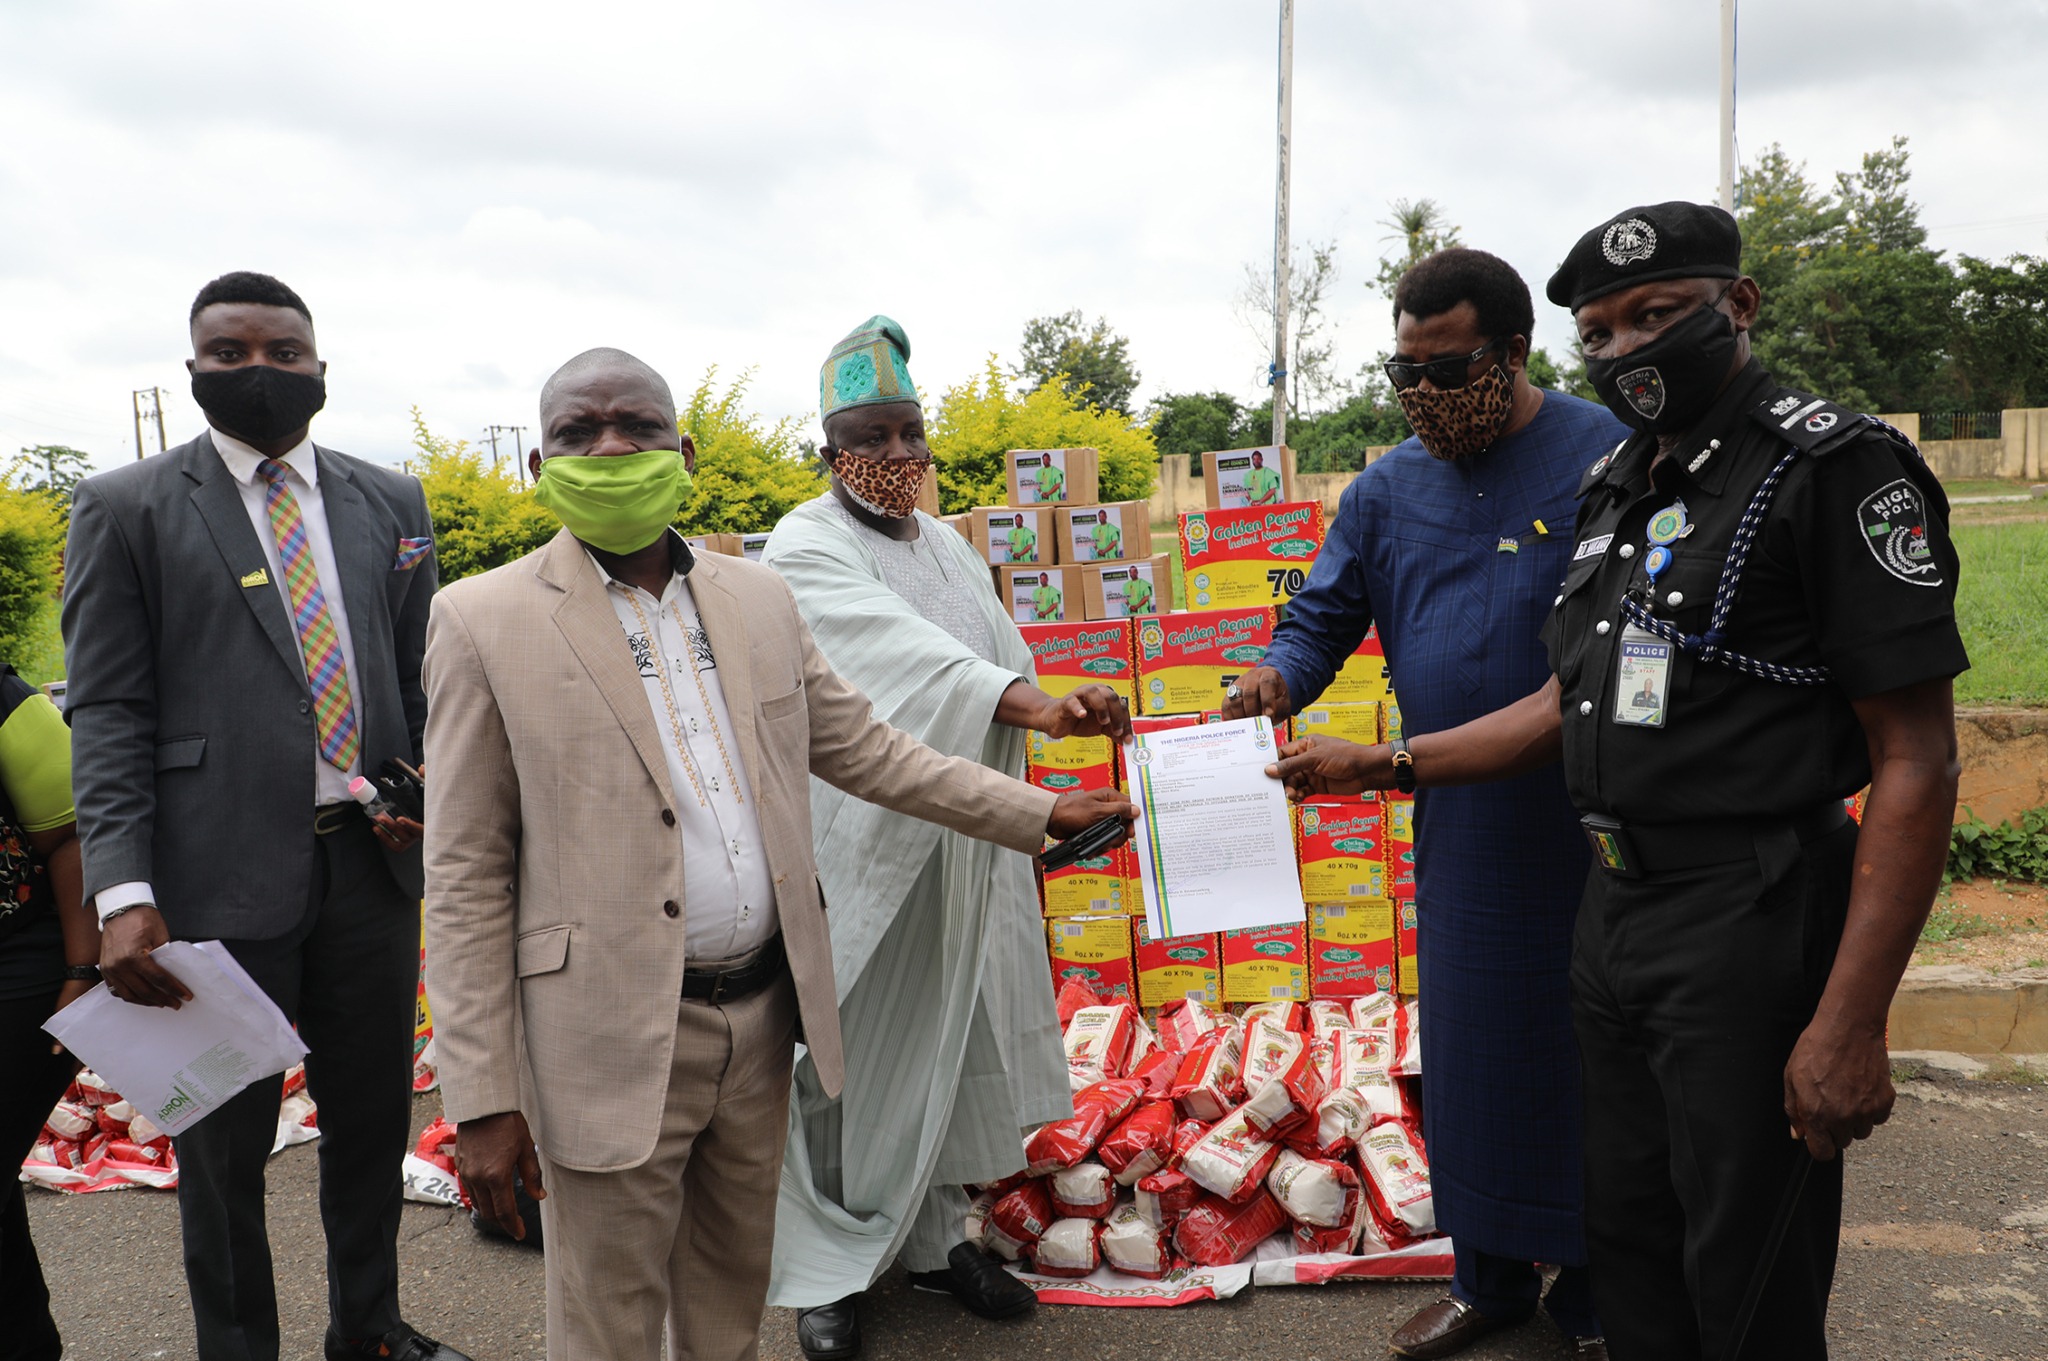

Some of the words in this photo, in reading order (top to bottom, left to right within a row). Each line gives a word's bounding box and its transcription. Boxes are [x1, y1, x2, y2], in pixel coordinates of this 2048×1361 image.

[1882, 502, 1911, 520] POL
[1213, 520, 1262, 541] Golden
[1265, 508, 1310, 528] Penny
[1228, 534, 1260, 550] Instant
[1262, 526, 1298, 541] Noodles
[1282, 541, 1306, 549] Chicken
[1168, 625, 1216, 646] Golden
[1218, 614, 1263, 634] Penny
[1030, 636, 1075, 656] Golden
[1078, 628, 1121, 646] Penny
[1183, 639, 1213, 655] Instant
[1215, 632, 1252, 647] Noodles
[1626, 646, 1665, 656] POLICE
[1043, 650, 1072, 664] Instant
[1074, 644, 1110, 658] Noodles
[1174, 736, 1200, 744] NIGERIA
[1320, 820, 1350, 831] Golden
[1352, 815, 1380, 826] Penny
[1316, 974, 1342, 984] Penny
[1345, 970, 1374, 980] Golden
[158, 1086, 191, 1120] ADRON
